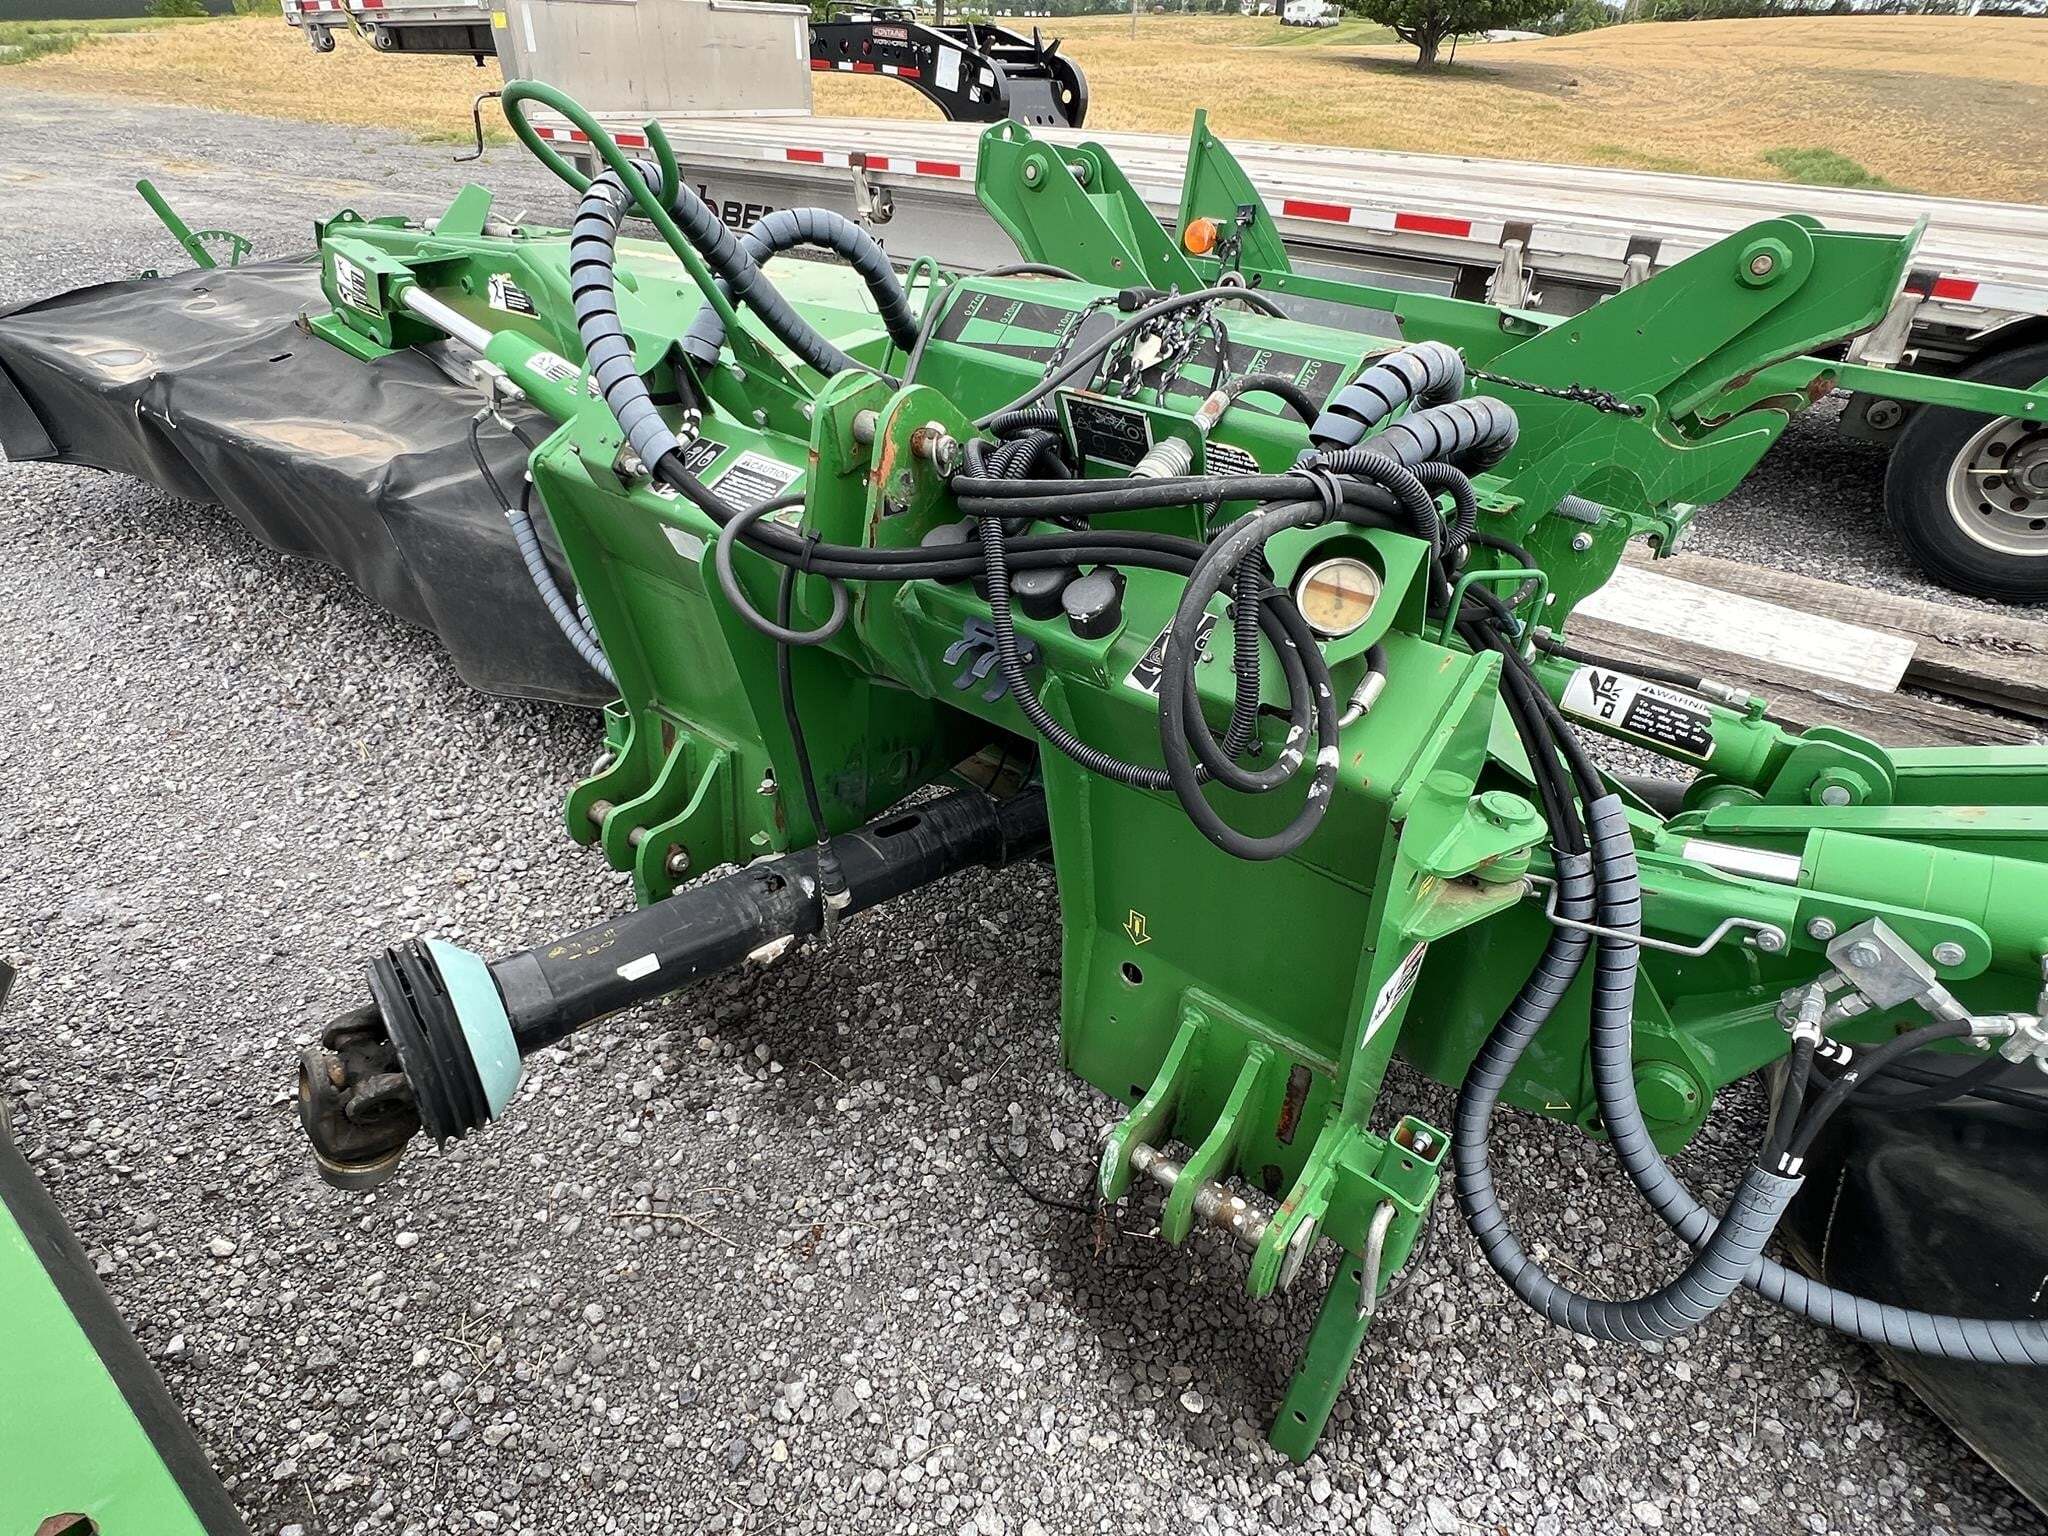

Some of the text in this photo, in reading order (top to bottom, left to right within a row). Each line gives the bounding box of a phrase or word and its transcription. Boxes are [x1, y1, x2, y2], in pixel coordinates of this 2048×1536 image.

[964, 293, 983, 316] 0.27m
[1000, 301, 1019, 323] 0.20m
[1054, 312, 1073, 334] 0.10m
[1300, 361, 1322, 388] 0.27m
[750, 461, 792, 480] CAUTION
